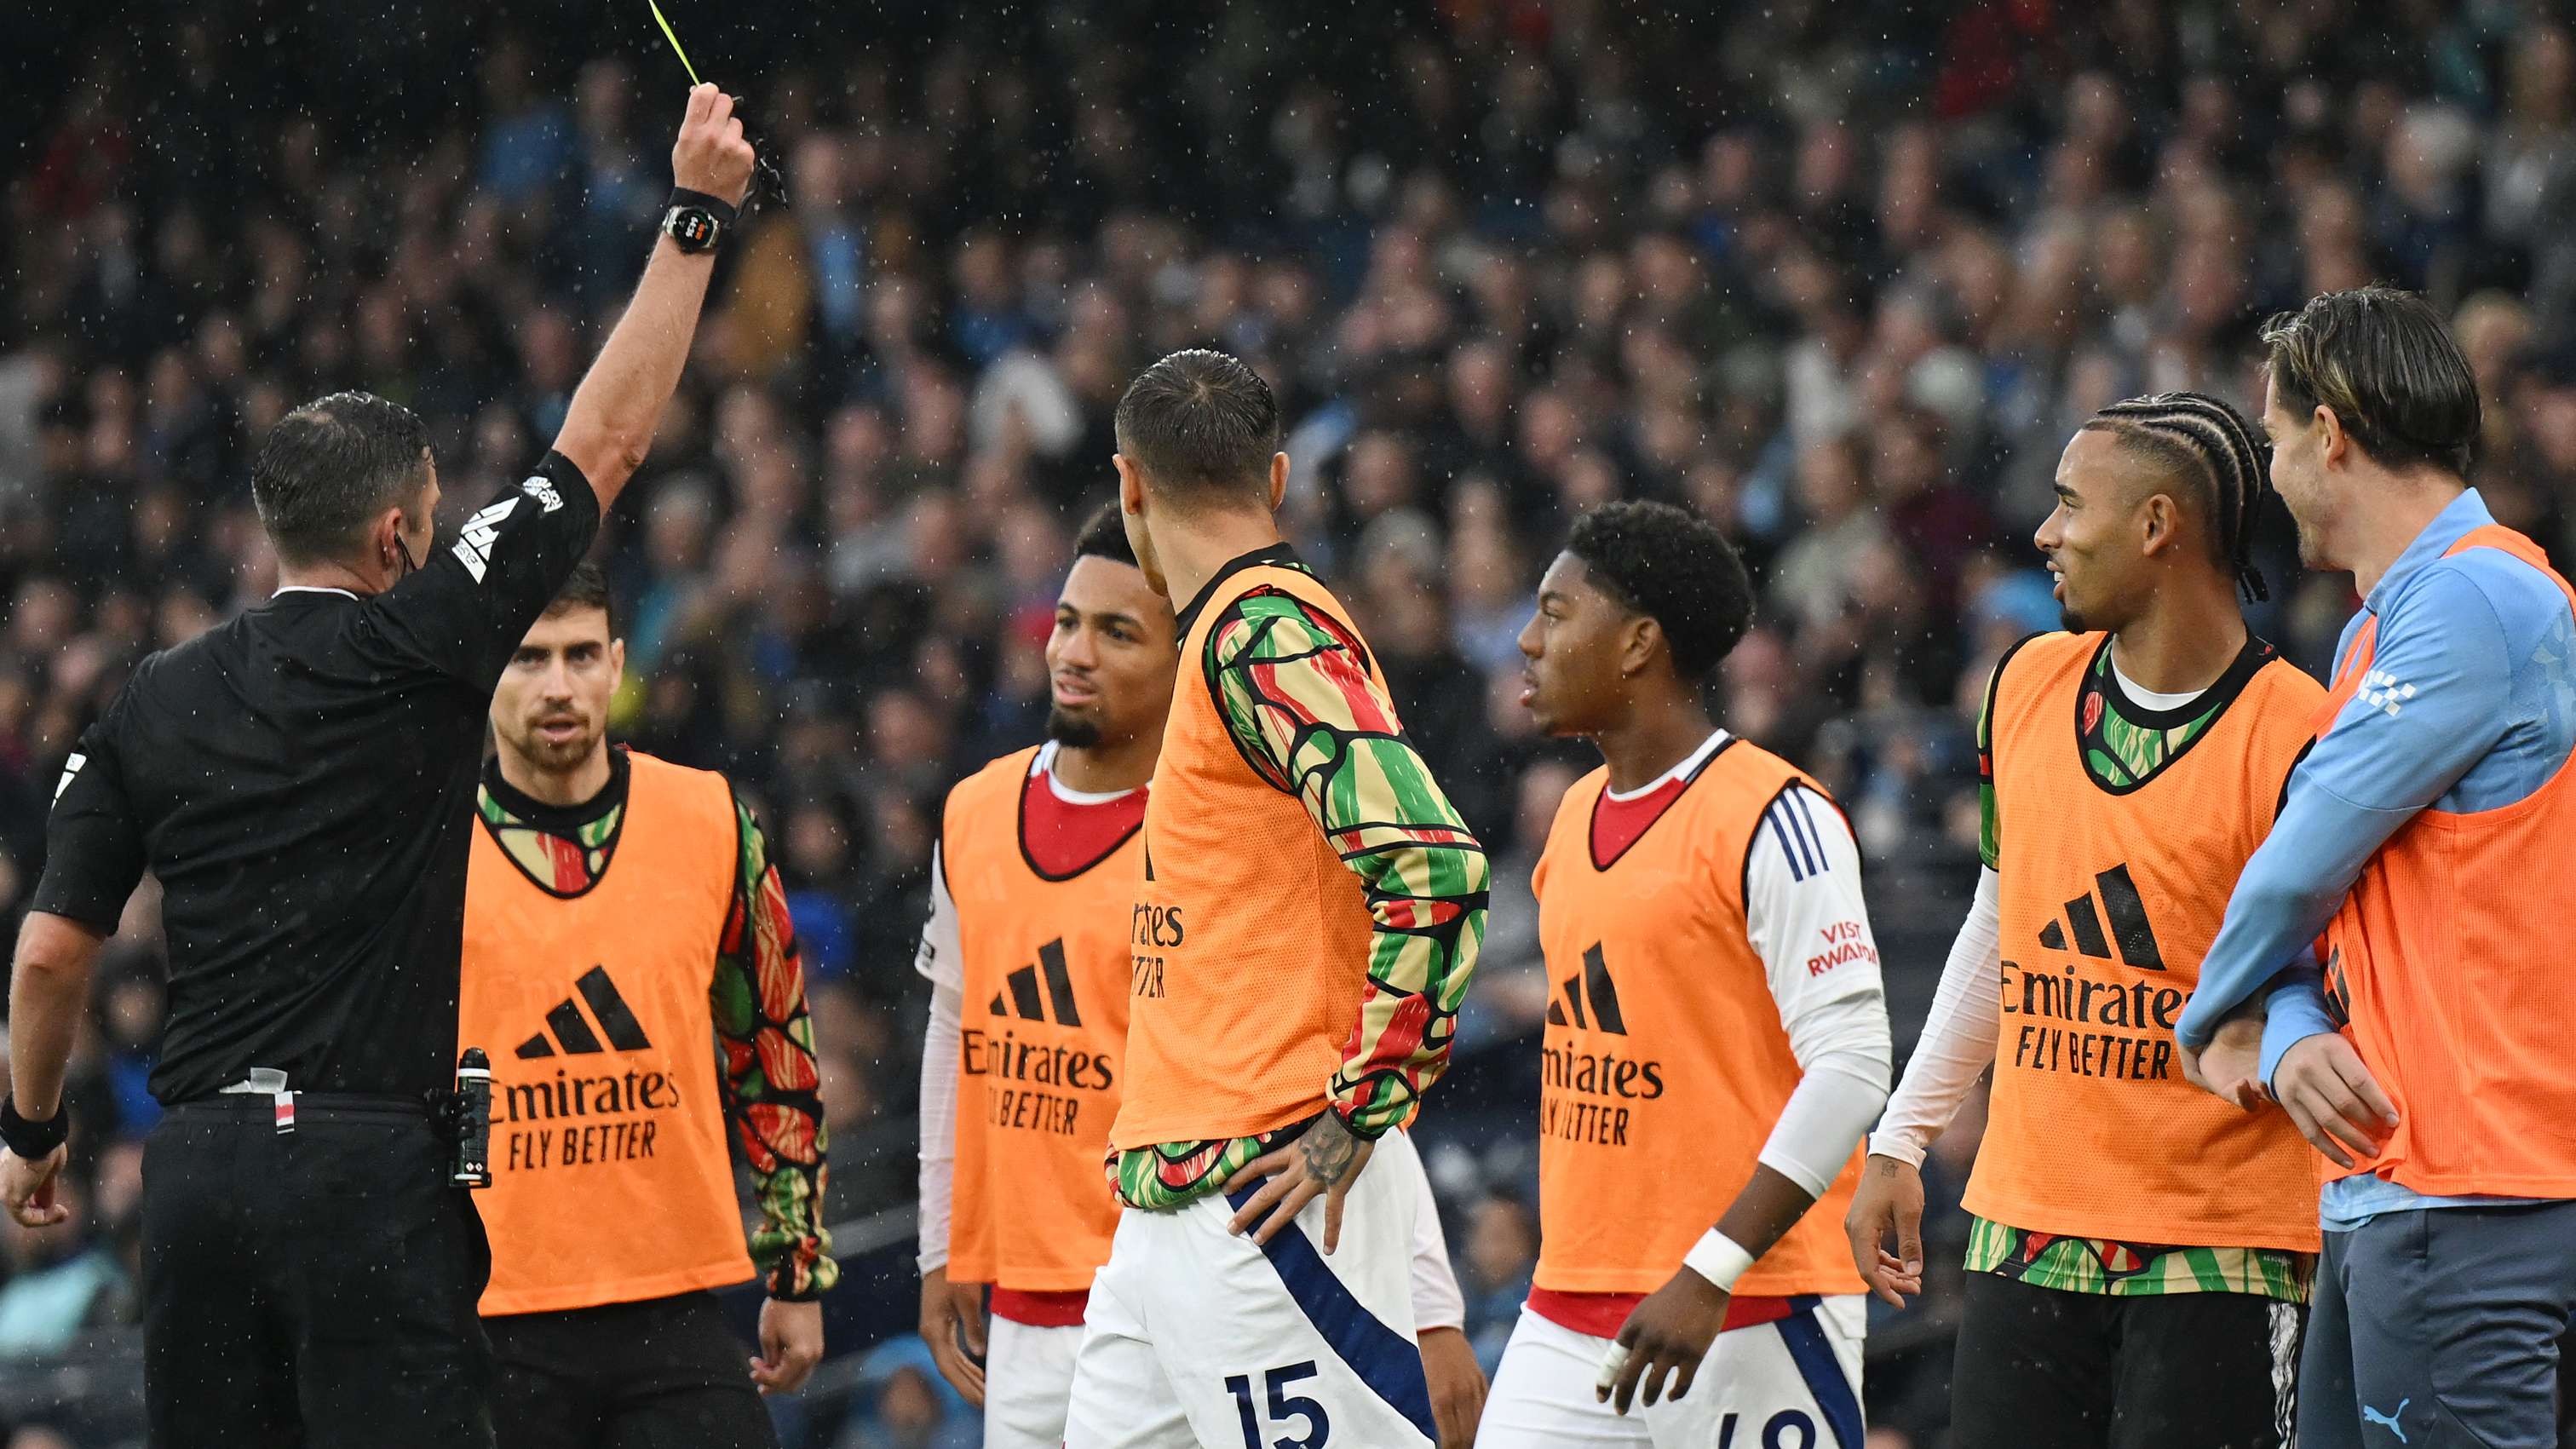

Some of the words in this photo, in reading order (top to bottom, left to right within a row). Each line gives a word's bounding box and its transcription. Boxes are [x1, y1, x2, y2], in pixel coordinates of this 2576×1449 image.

[1820, 921, 1860, 945] VIST
[1542, 1041, 1663, 1099] miates
[2015, 1026, 2061, 1071] FLY
[2069, 1032, 2171, 1081] BETTER
[509, 1129, 553, 1170] FLY
[562, 1120, 656, 1165] BETTER
[1560, 1101, 1629, 1146] TTER
[1224, 1360, 1330, 1449] 15
